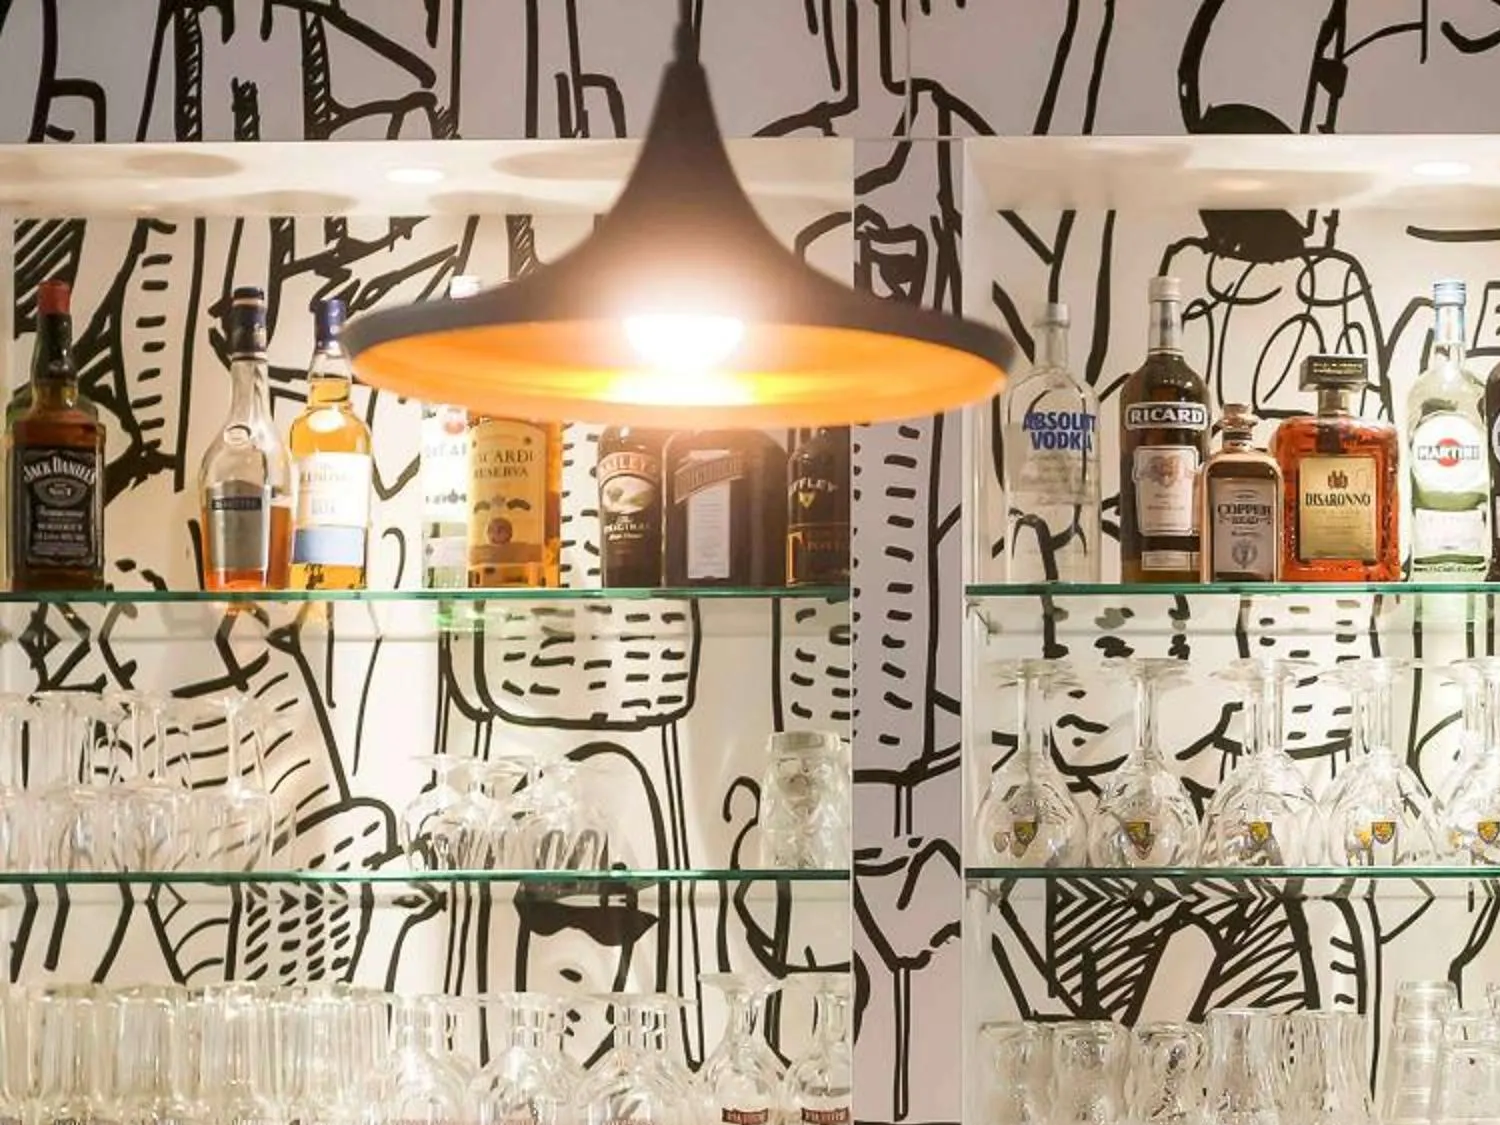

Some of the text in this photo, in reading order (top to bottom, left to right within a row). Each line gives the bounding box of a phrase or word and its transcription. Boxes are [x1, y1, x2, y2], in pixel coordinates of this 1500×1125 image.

[1023, 411, 1096, 432] ABSOLUT
[1130, 408, 1203, 423] RICARD
[1031, 431, 1092, 451] VODKA
[1305, 492, 1371, 507] DISARONNO
